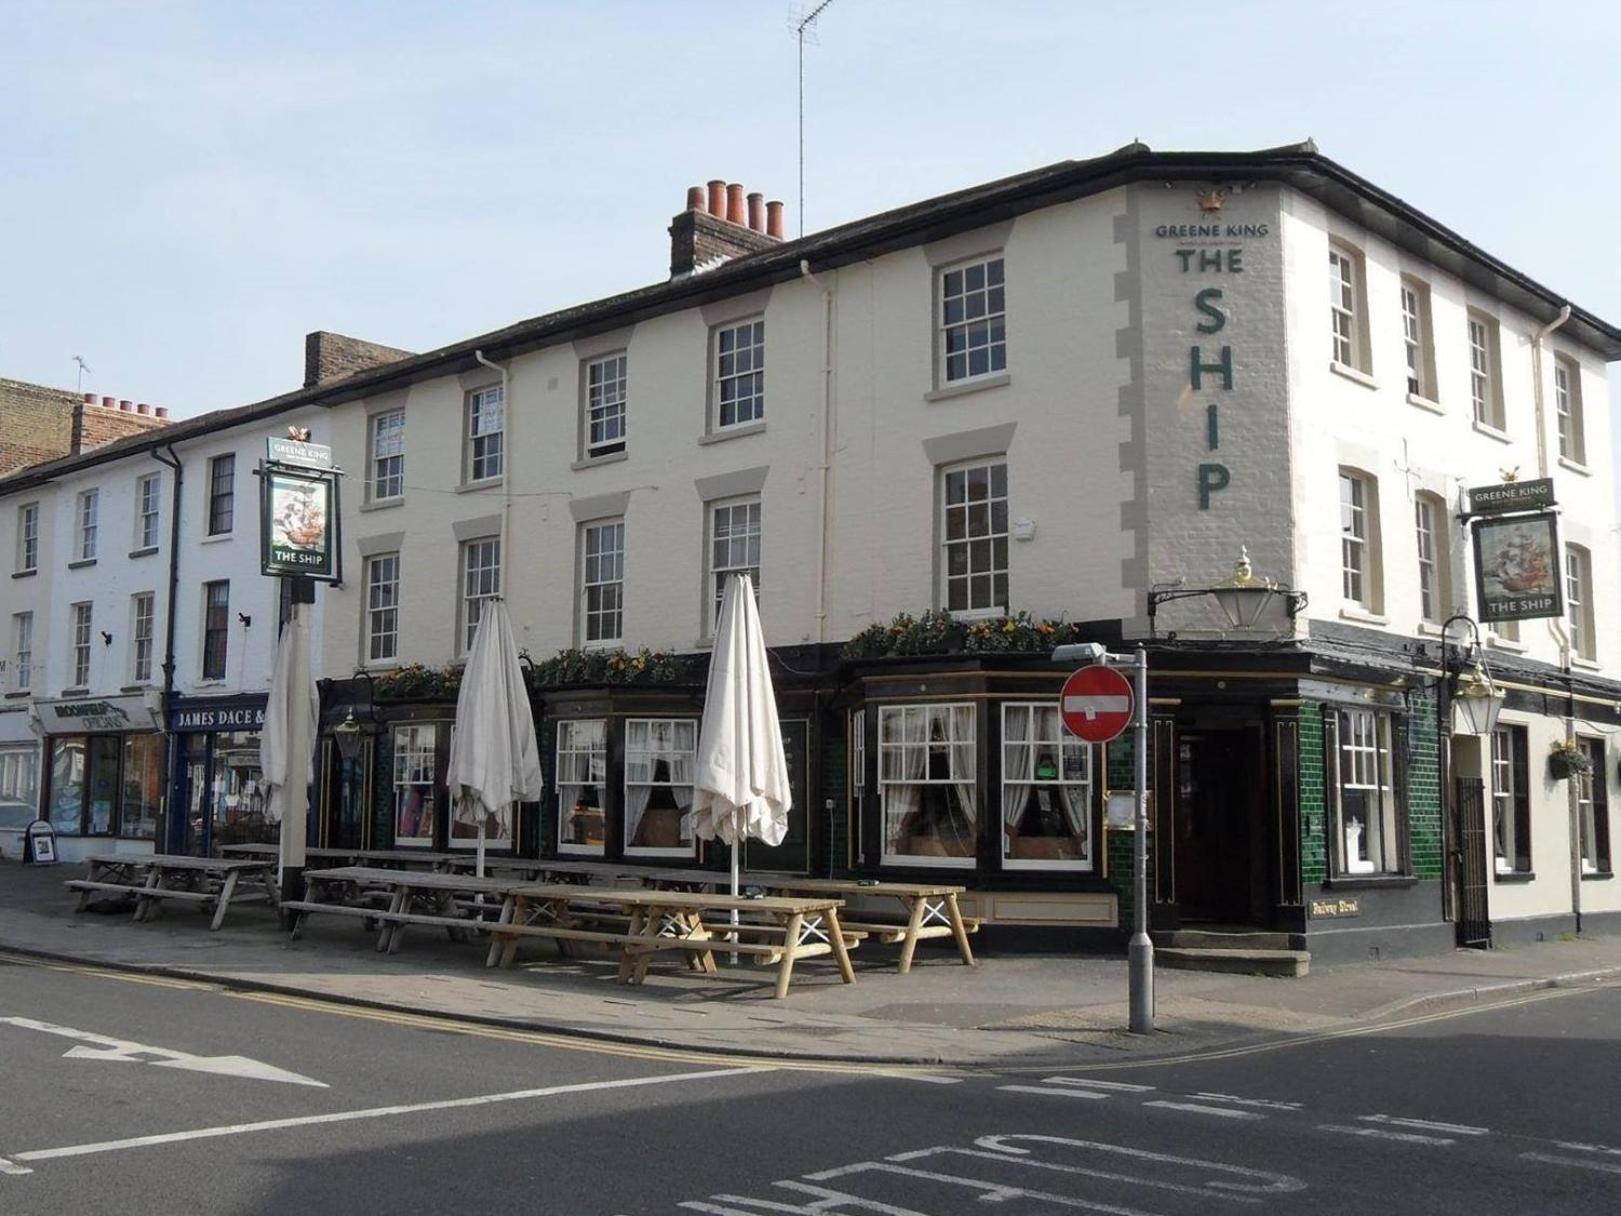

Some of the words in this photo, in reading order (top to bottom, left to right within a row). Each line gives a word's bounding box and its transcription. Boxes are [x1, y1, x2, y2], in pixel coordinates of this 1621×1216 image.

[1155, 225, 1220, 238] GREENE
[1226, 224, 1269, 237] KING
[1176, 249, 1243, 273] THE
[1191, 288, 1233, 510] SHIP
[1475, 488, 1518, 502] GREENE
[1519, 485, 1548, 497] KING
[275, 550, 297, 563] THE
[299, 553, 323, 565] SHIP
[1489, 602, 1517, 613] THE
[1522, 599, 1553, 611] SHIP
[179, 711, 215, 727] JAMES
[219, 710, 252, 725] DACE
[256, 709, 265, 724] &
